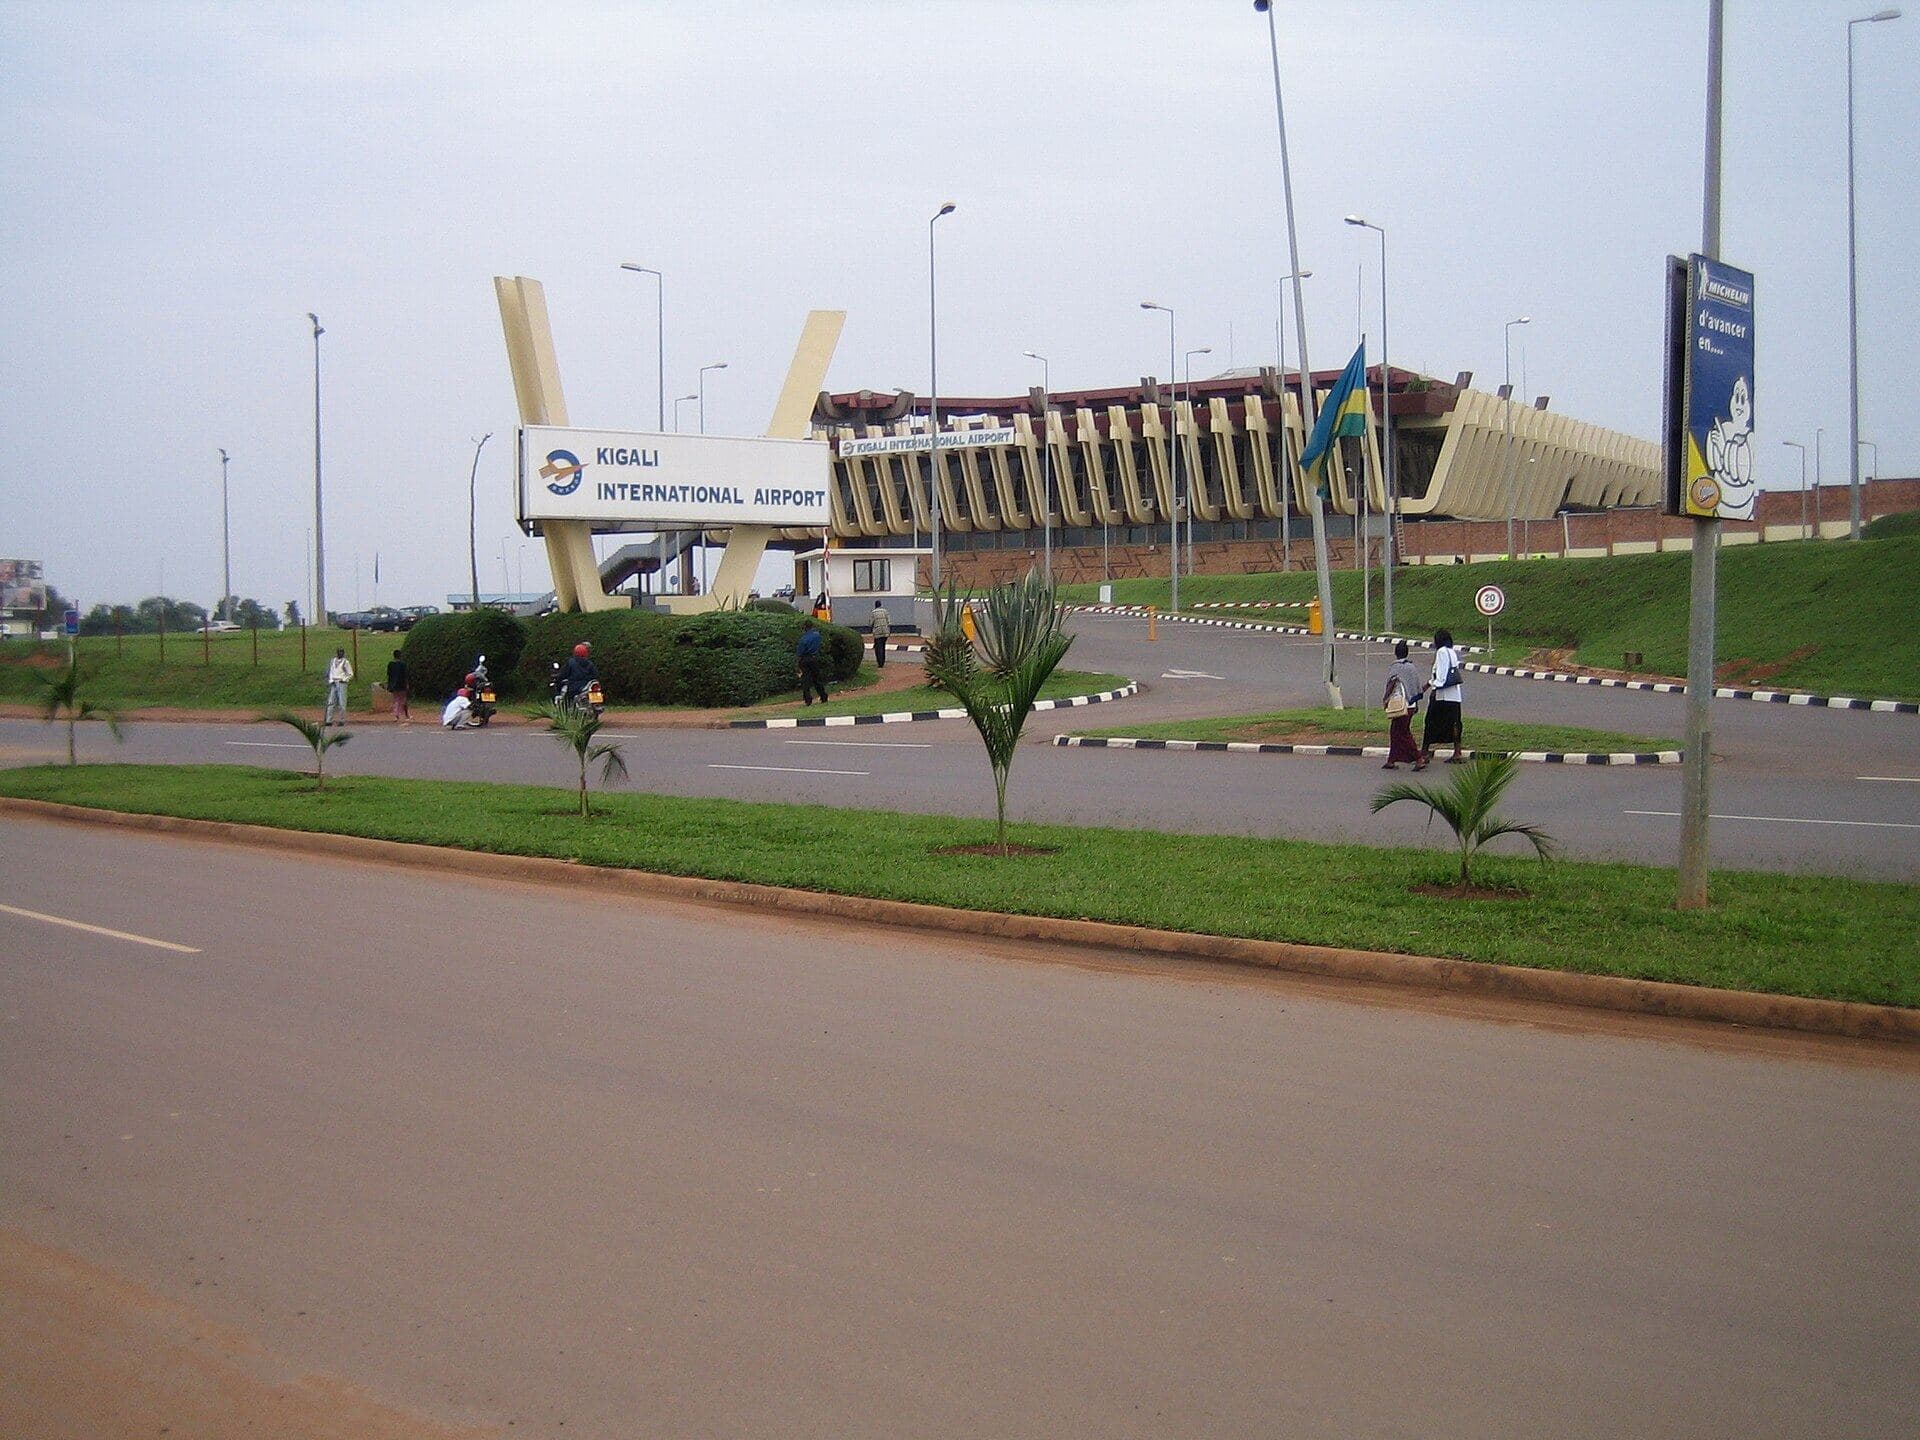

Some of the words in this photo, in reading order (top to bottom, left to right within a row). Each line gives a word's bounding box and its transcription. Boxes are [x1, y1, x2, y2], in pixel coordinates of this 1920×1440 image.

[1708, 281, 1749, 304] MICHELIN
[1699, 310, 1746, 338] d'avancer
[857, 440, 887, 453] KIGALI
[967, 431, 1010, 445] AIRPORT
[597, 447, 659, 467] KIGALI
[597, 483, 744, 505] INTERNATIONAL
[753, 488, 826, 507] AIRPORT
[1485, 594, 1495, 602] 20
